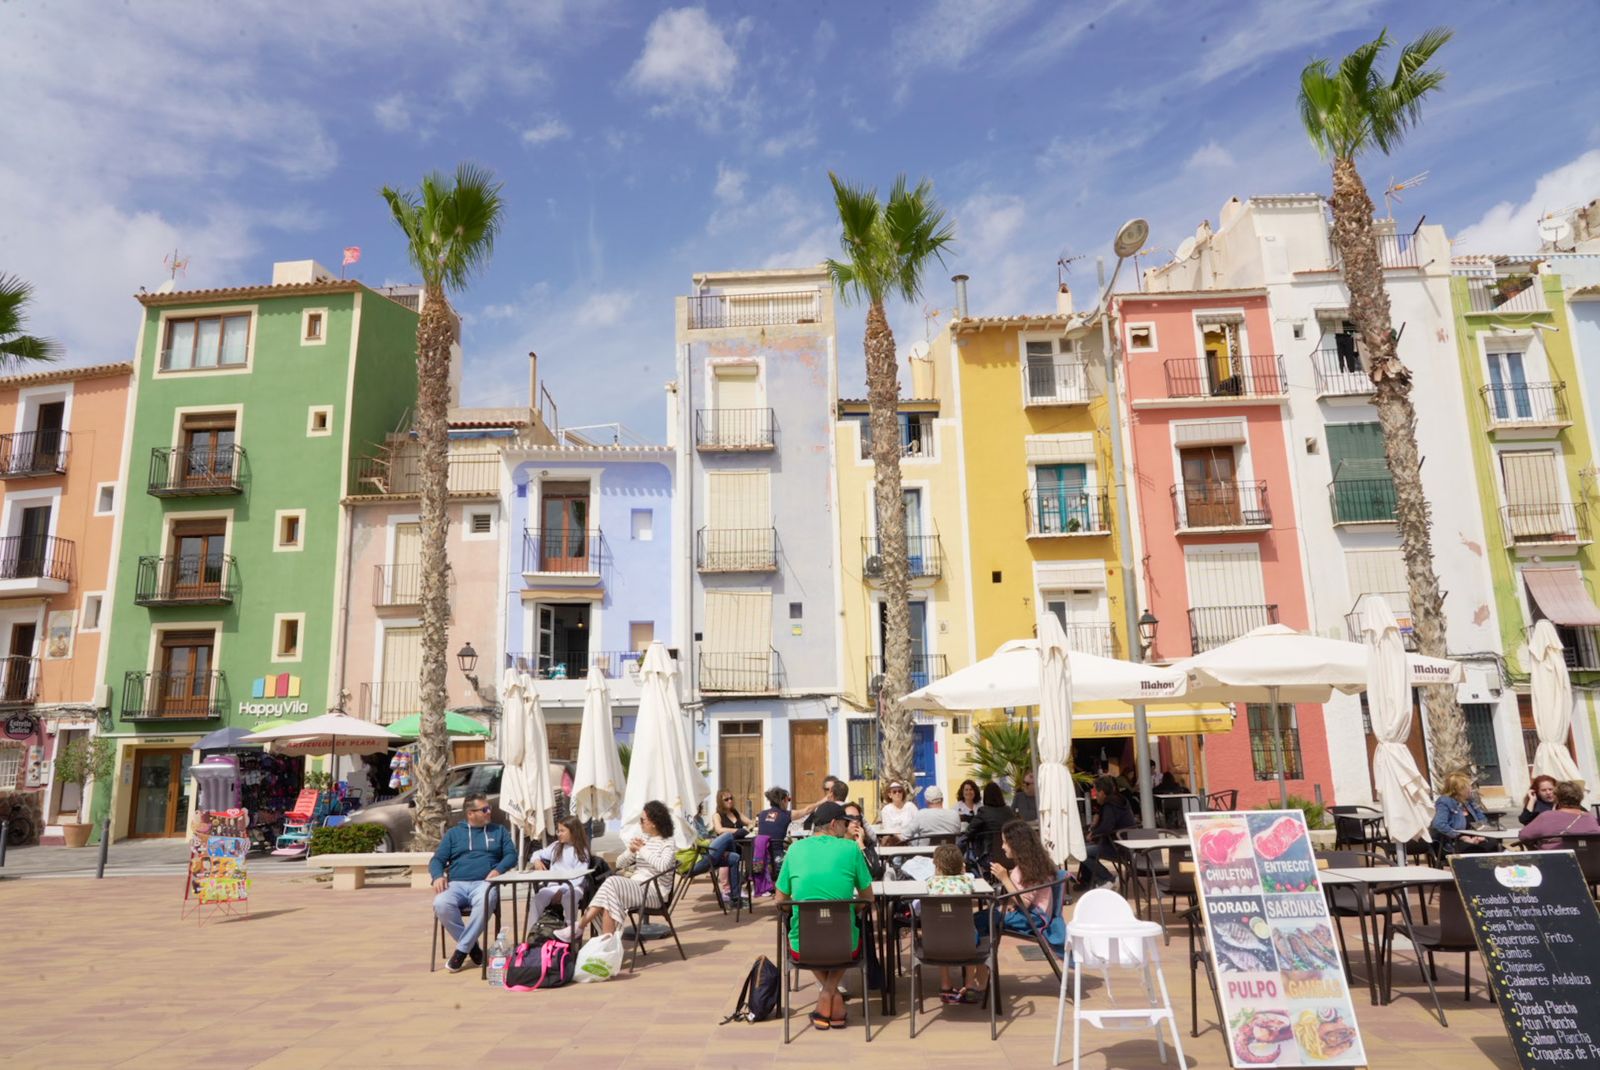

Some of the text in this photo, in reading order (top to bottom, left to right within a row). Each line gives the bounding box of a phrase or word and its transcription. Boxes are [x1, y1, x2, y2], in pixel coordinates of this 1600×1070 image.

[1413, 664, 1450, 674] Mahou
[1140, 680, 1174, 690] Mahou
[239, 702, 308, 717] HappyVila
[1206, 866, 1253, 880] CHULETÓN
[1264, 860, 1310, 873] ENTRECOT
[1476, 892, 1539, 905] Ensaladas Variadas
[1208, 901, 1260, 914] DORADA
[1267, 899, 1327, 917] SARDINAS
[1480, 906, 1512, 918] Sardinas
[1511, 905, 1542, 916] Plancha
[1485, 919, 1536, 933] Sepia Plancha
[1490, 932, 1574, 947] Boquerones Fritos
[1496, 946, 1532, 959] Gambas
[1500, 961, 1545, 975] Chipirones
[1505, 972, 1591, 987] Calamares Andaluza
[1228, 980, 1277, 999] PULPO
[1509, 988, 1533, 1003] Pulpo
[1514, 1000, 1578, 1015] Dorada Plancha
[1522, 1015, 1577, 1030] Atun Plancha
[1525, 1030, 1592, 1045] Salmon Plancha
[1531, 1046, 1574, 1064] Croquetas
[1576, 1044, 1588, 1060] de
